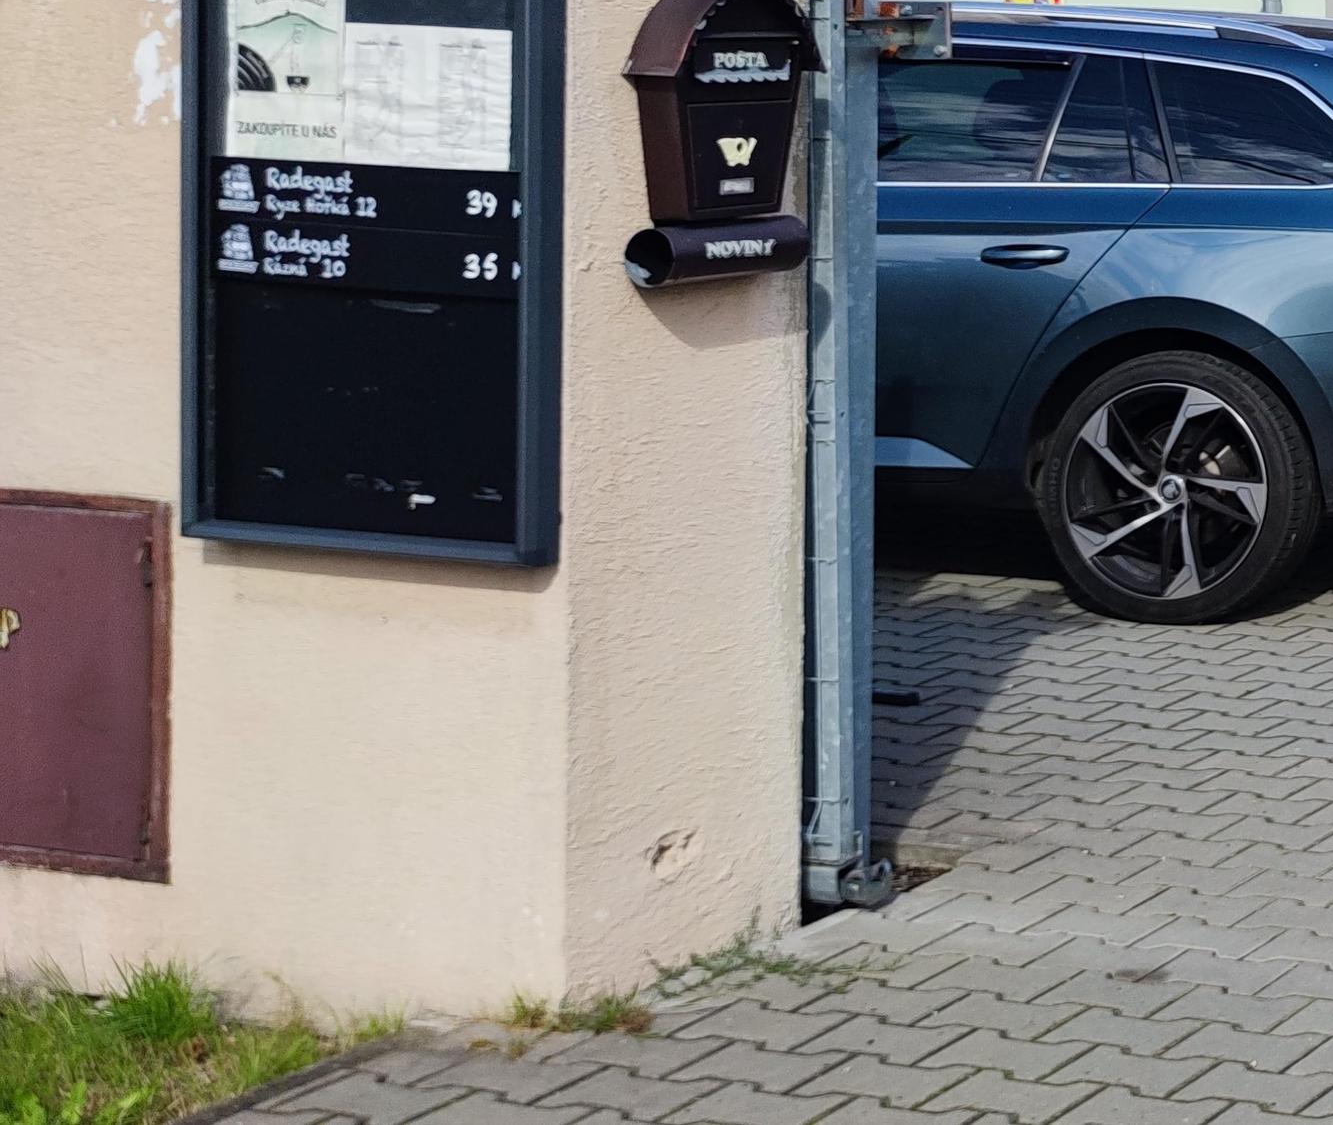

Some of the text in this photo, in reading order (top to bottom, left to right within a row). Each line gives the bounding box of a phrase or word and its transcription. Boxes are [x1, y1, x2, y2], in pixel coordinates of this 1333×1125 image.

[264, 165, 354, 198] Radegast
[353, 196, 378, 218] 12
[465, 189, 498, 218] 39
[263, 229, 351, 263] Radegast
[704, 237, 777, 259] NOVINY
[318, 258, 346, 279] 10
[462, 252, 498, 281] 35
